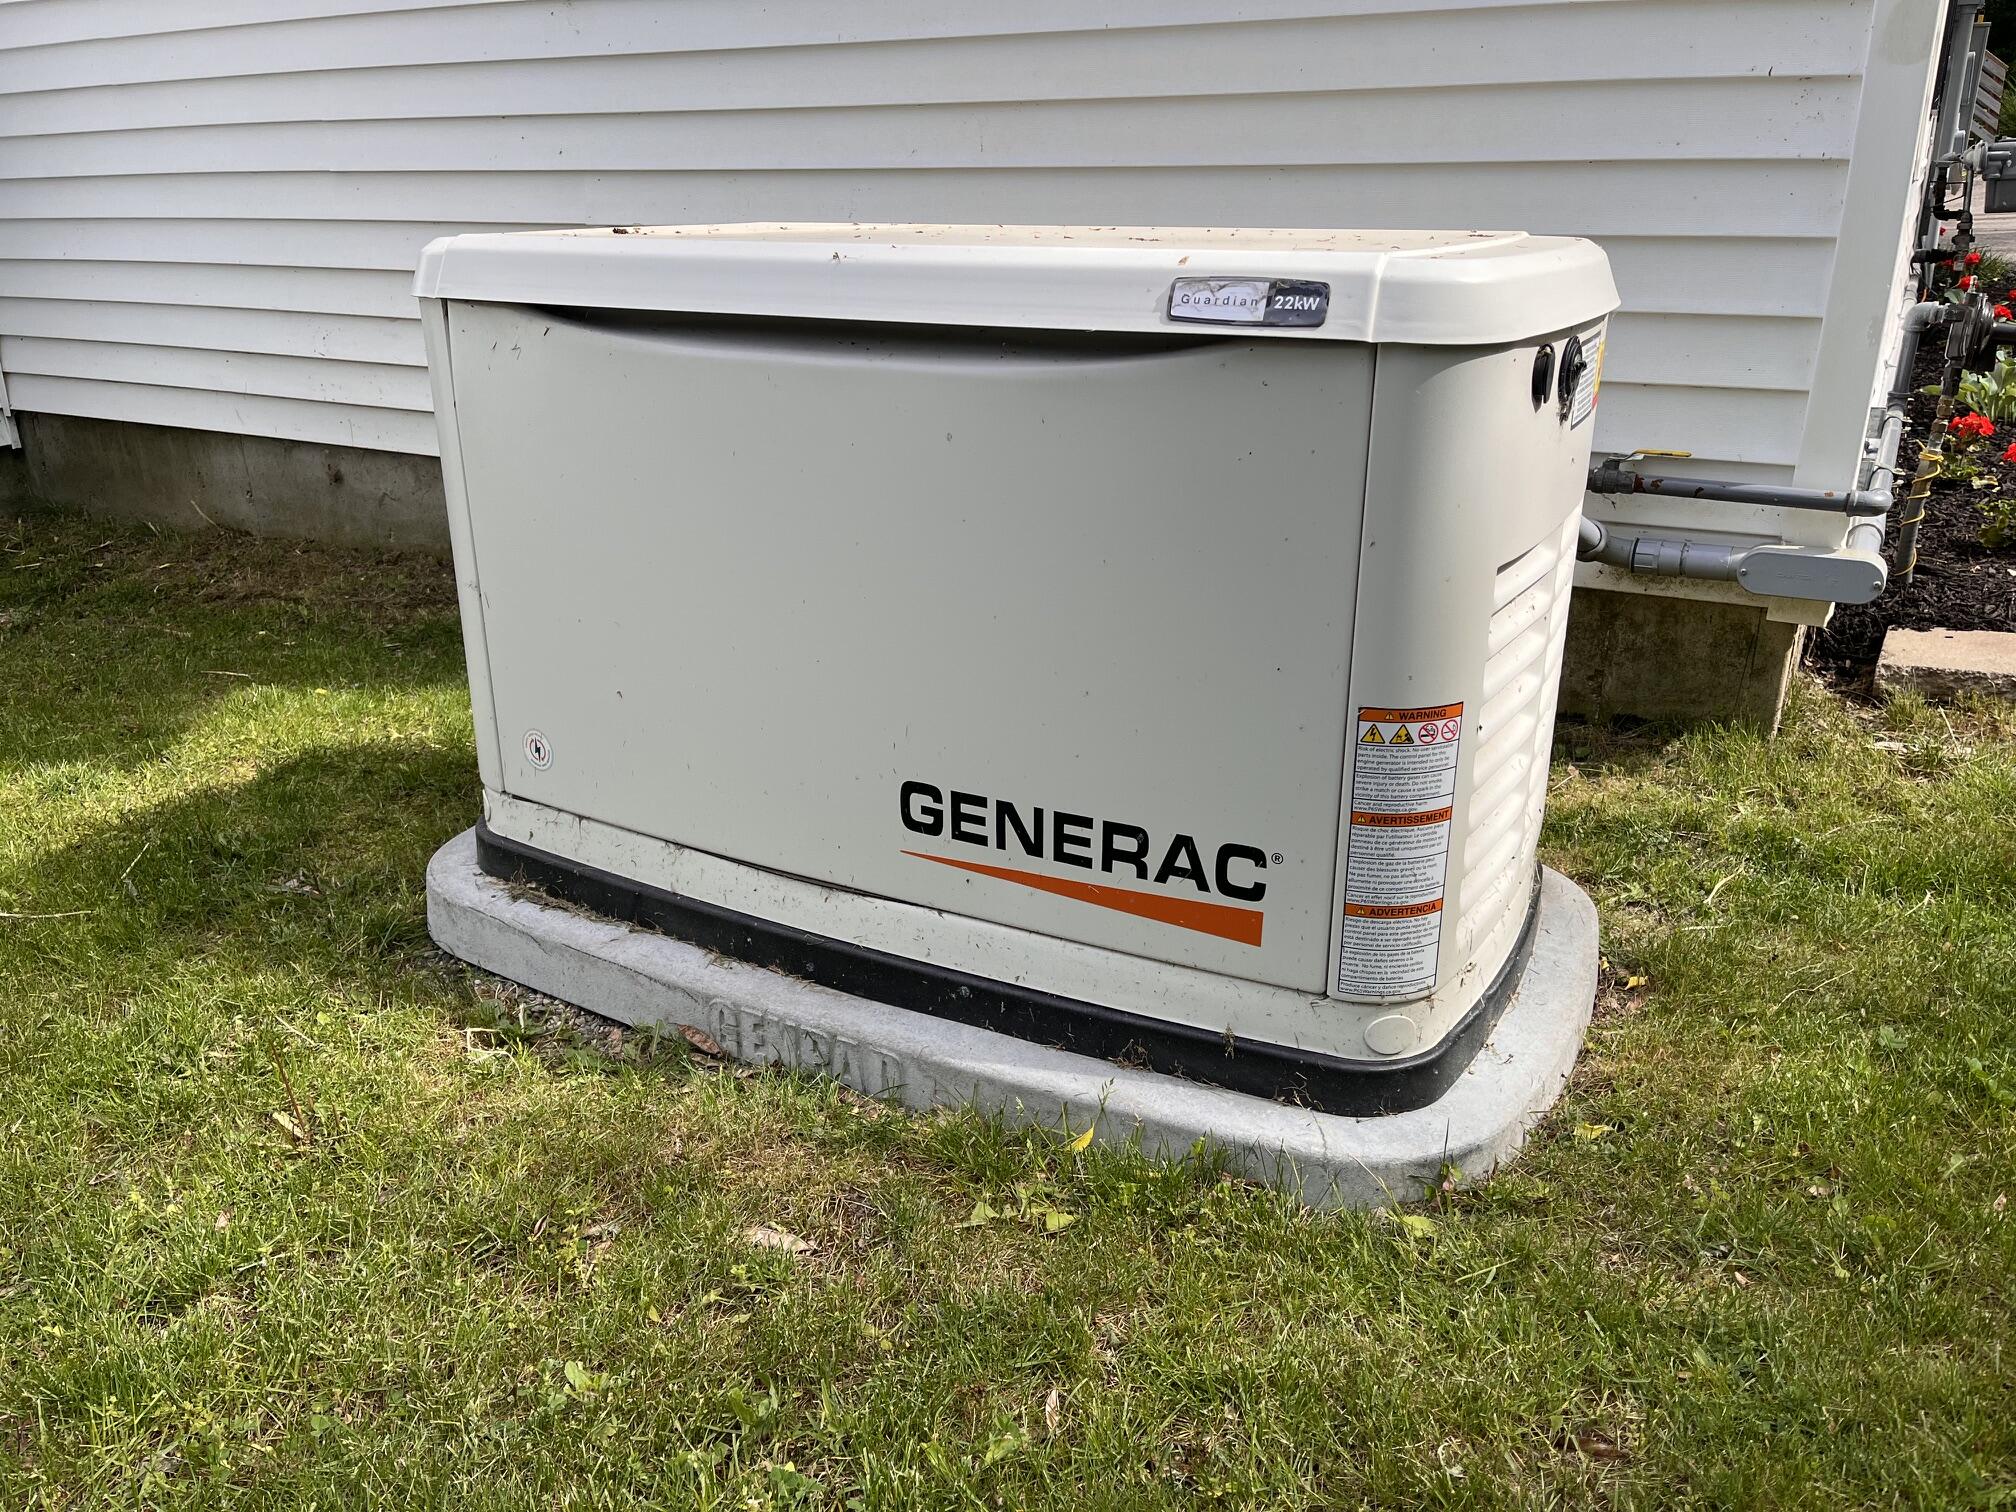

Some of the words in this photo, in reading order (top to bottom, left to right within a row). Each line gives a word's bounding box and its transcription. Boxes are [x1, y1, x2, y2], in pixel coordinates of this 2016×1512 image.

[1181, 293, 1258, 307] Guardian
[1273, 296, 1320, 311] 22kW
[1399, 709, 1447, 720] WARNING
[1368, 810, 1449, 825] AVERTISSEMENT
[1369, 903, 1436, 916] ADVERTENCIA
